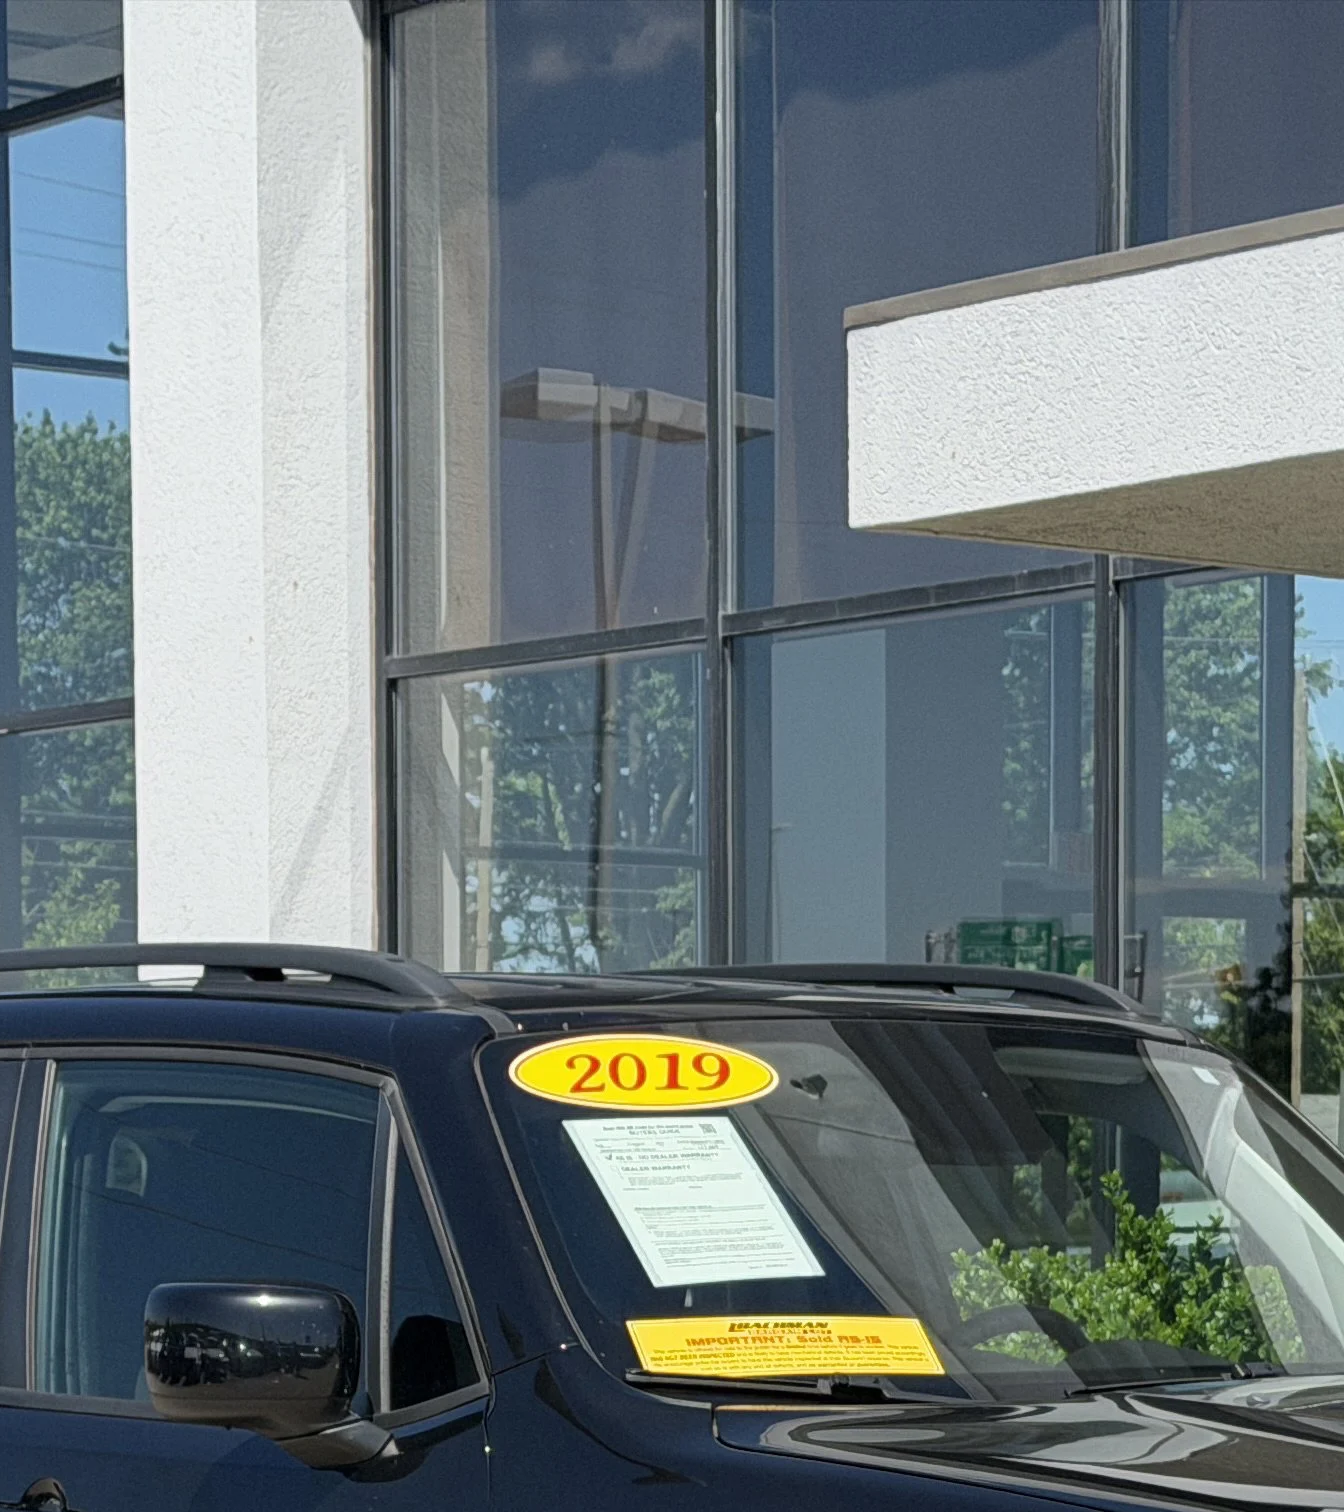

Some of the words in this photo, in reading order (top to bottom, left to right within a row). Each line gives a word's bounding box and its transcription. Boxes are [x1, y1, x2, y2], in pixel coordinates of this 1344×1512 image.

[565, 1053, 731, 1093] 2019
[685, 1335, 791, 1347] IMPORTANT:
[797, 1335, 833, 1343] Sold
[837, 1335, 882, 1344] AS-IS
